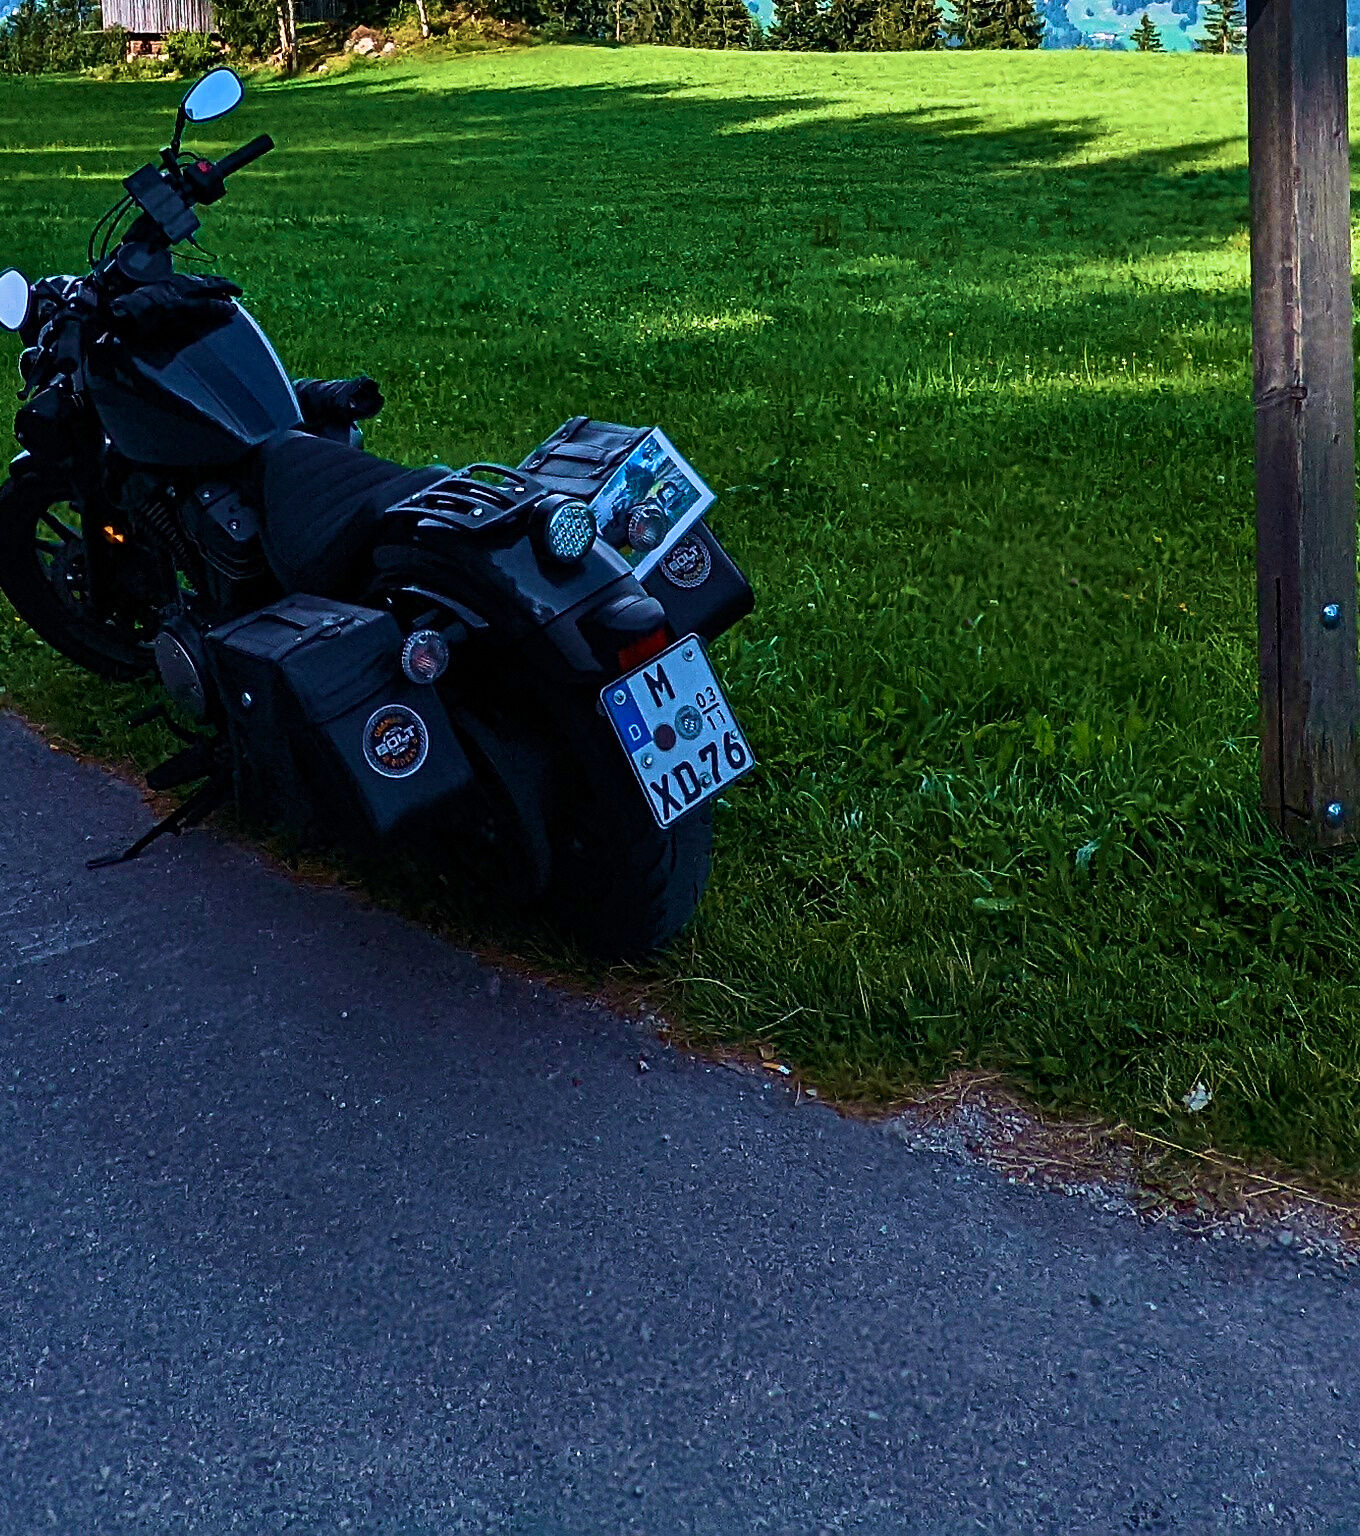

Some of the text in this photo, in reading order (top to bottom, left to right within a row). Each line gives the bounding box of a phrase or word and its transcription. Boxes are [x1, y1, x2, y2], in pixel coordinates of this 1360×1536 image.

[643, 663, 676, 708] M
[696, 686, 717, 709] 03
[628, 723, 642, 741] D
